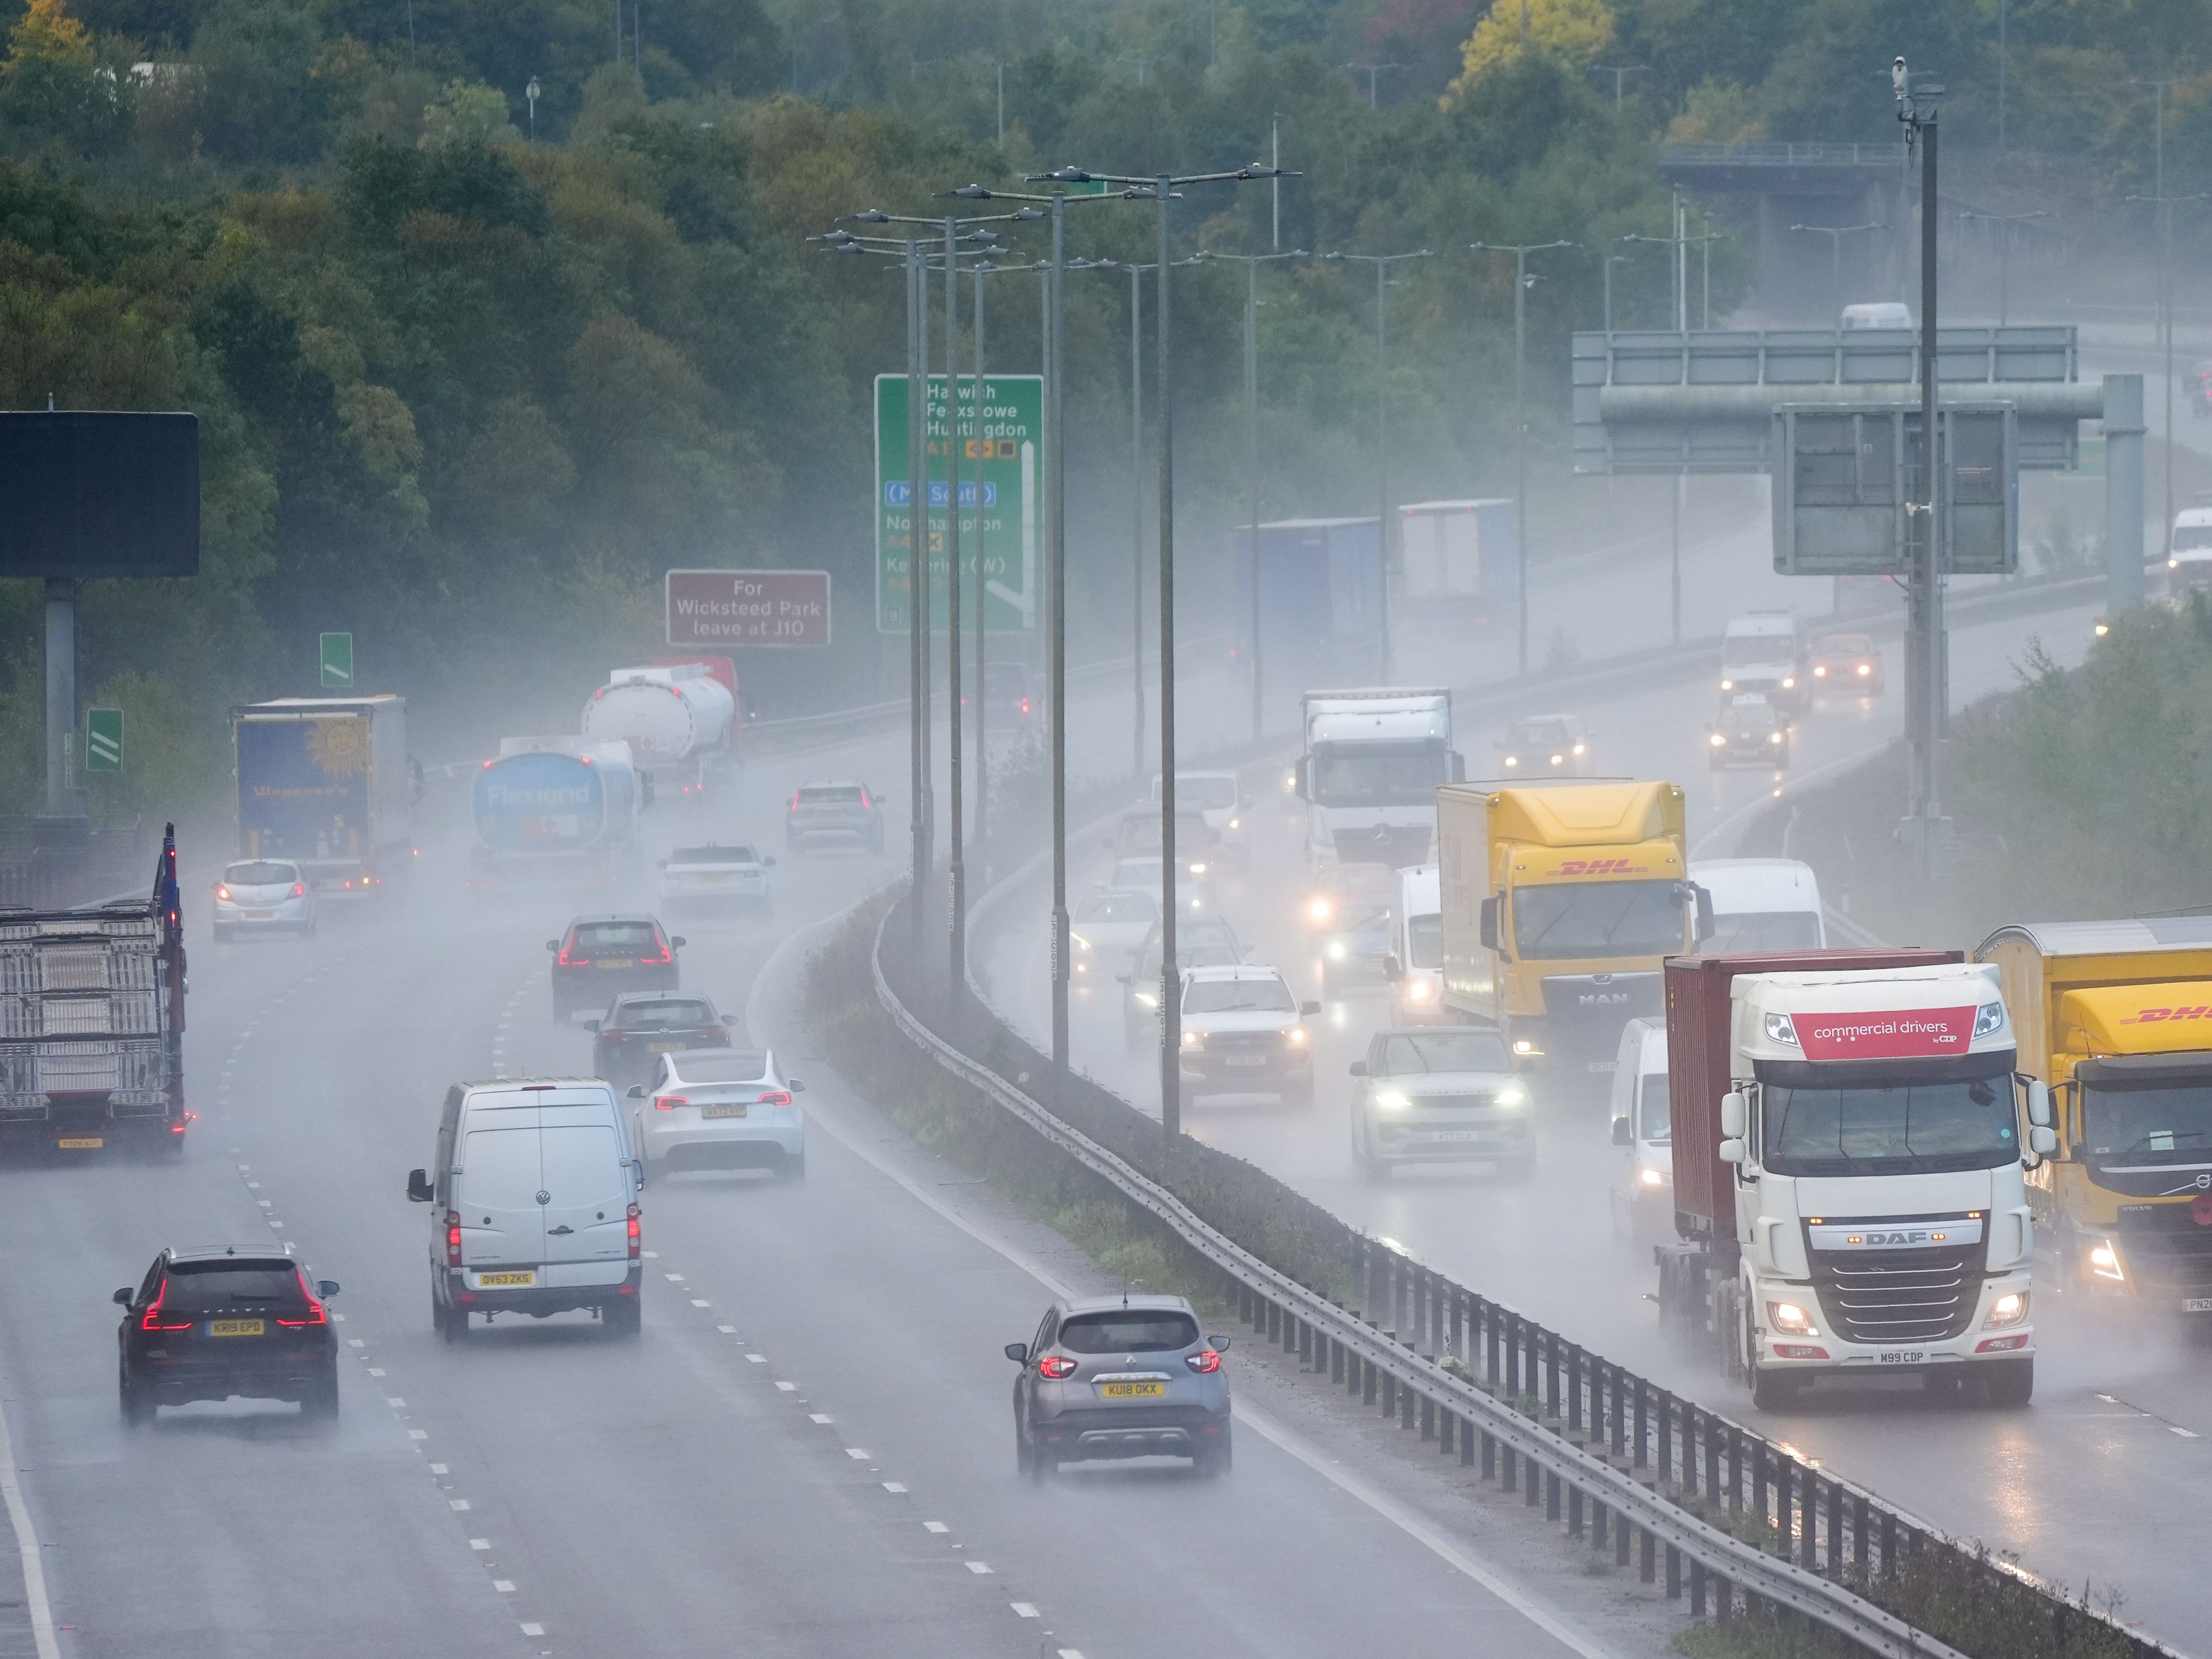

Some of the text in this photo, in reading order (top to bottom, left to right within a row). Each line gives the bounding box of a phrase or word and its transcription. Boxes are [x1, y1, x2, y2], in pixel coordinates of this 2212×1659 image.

[927, 384, 996, 399] Hawih
[927, 403, 1017, 418] Fexsowe
[927, 420, 1026, 438] Hutigdon
[886, 515, 1001, 533] Nohapton
[734, 580, 763, 595] For
[677, 599, 820, 616] Wicksteed Park
[694, 619, 804, 636] leave at J10
[1559, 859, 1635, 876] DHL
[1579, 993, 1628, 1006] MAN
[1814, 1020, 1948, 1039] commercial drivers
[1866, 1232, 1926, 1245] DAF
[1881, 1352, 1923, 1363] M99 CDP
[1109, 1385, 1132, 1395] KU18
